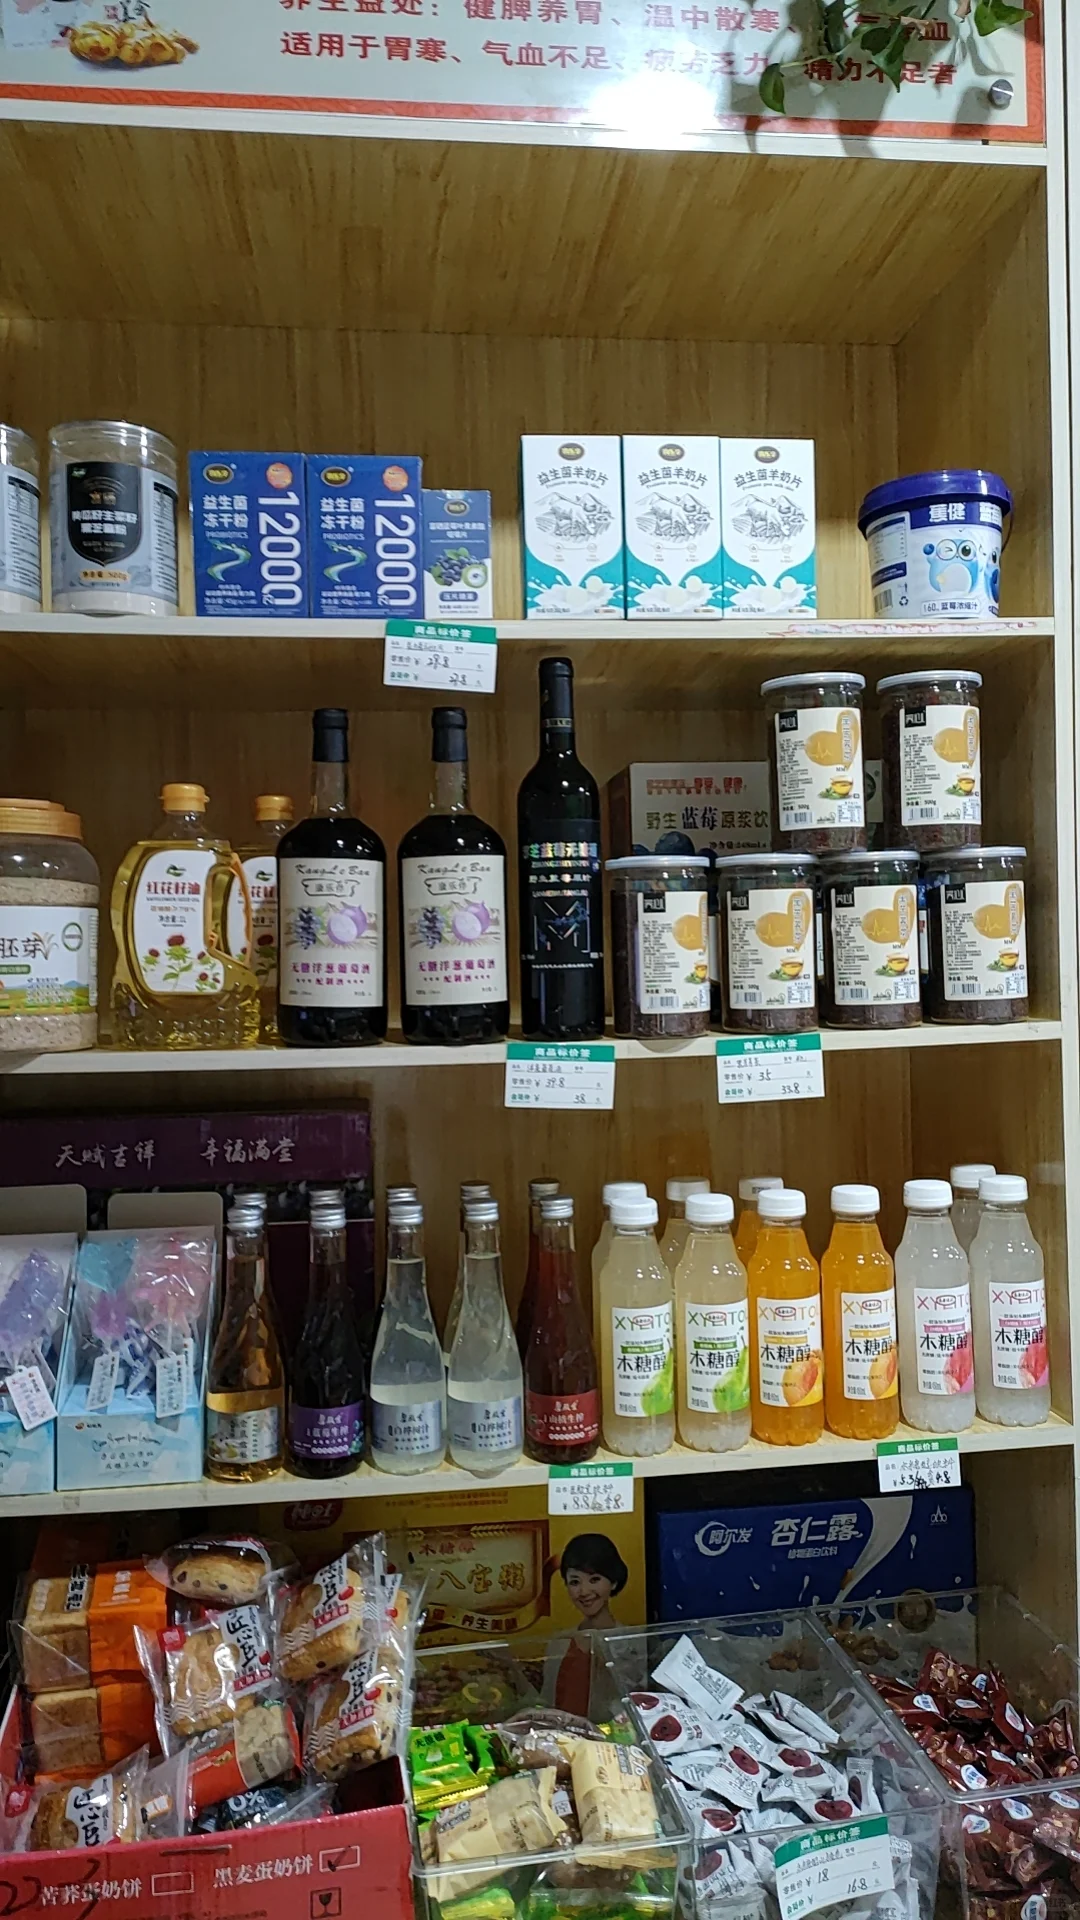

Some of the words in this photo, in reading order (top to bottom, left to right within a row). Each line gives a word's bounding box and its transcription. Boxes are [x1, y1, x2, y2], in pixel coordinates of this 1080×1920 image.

[536, 466, 609, 487] 益生菌羊奶片
[637, 466, 708, 486] 益生菌羊奶片
[733, 468, 803, 489] 益生菌羊奶片
[203, 495, 248, 510] 益生菌
[320, 498, 365, 512] 益生菌
[203, 514, 249, 528] 冻干粉
[320, 515, 365, 530] 冻干粉
[414, 626, 472, 638] 商品标价签
[646, 806, 769, 830] 野生蓝莓原浆饮
[146, 882, 200, 896] 红花籽油
[291, 962, 370, 973] 无糖洋葱葡萄酒
[418, 959, 495, 972] 无糖洋葱葡萄酒
[443, 976, 472, 984] 配制酒
[535, 1047, 591, 1058] 商品标价签
[743, 1038, 798, 1051] 商品标价签
[759, 1068, 772, 1081] 35
[200, 1137, 297, 1166] 幸福满堂
[844, 1335, 893, 1355] 木糖醇
[919, 1332, 968, 1351] 木糖醇
[994, 1326, 1044, 1346] 木糖醇
[617, 1350, 667, 1373] 木糖醇
[689, 1350, 741, 1369] 木糖醇
[760, 1344, 811, 1364] 木糖醇
[897, 1442, 940, 1453] 商品标价签
[570, 1467, 614, 1476] 商品标价签
[708, 1528, 753, 1546] 阿尔发
[771, 1513, 863, 1546] 杏仁露
[436, 1562, 526, 1594] 八宝粥
[228, 1790, 265, 1812] 0%
[800, 1826, 861, 1850] 商品标价签
[213, 1854, 313, 1888] 黑麦蛋奶饼
[783, 1880, 803, 1895] 零售价
[818, 1868, 829, 1884] 18
[41, 1877, 143, 1906] 苦荞蛋奶饼
